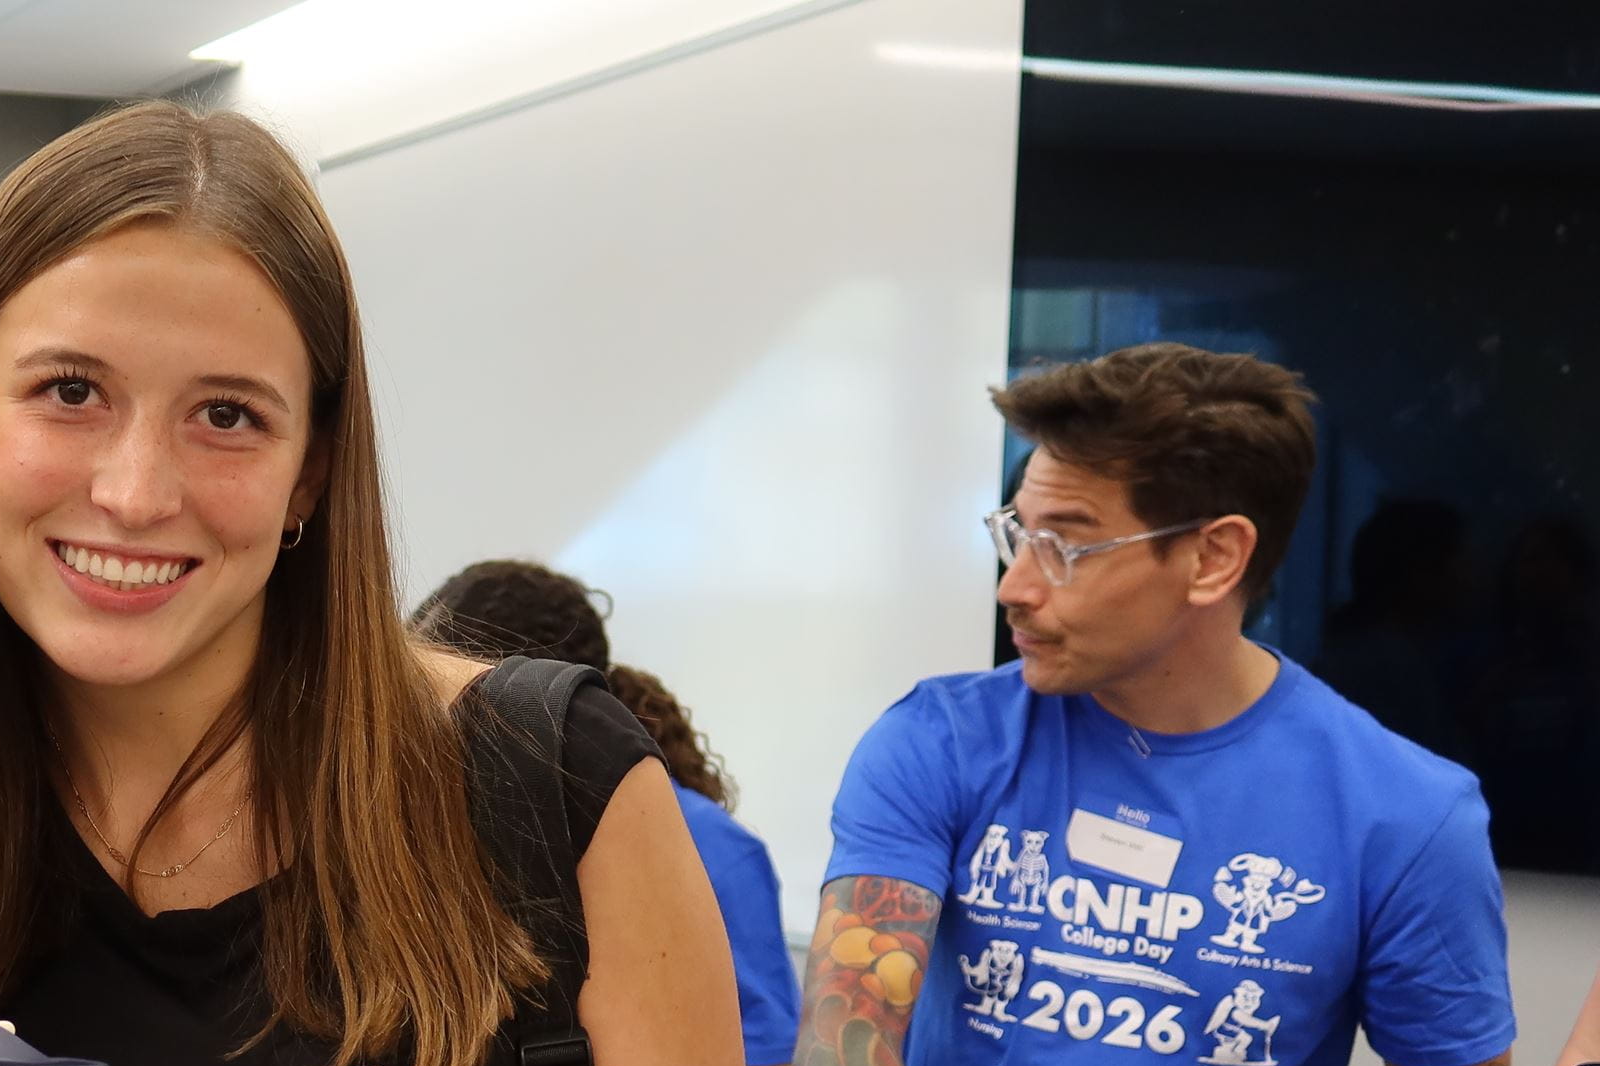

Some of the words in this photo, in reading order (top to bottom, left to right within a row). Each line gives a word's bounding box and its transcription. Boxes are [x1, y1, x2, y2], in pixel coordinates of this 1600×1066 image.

[1116, 803, 1151, 822] Hello
[967, 909, 1001, 927] Health
[1002, 915, 1041, 932] Science
[1047, 875, 1204, 941] CNHP
[1060, 924, 1131, 955] College
[1133, 936, 1175, 964] Day
[1196, 947, 1239, 968] Culinary
[1239, 955, 1261, 969] Arts
[1262, 958, 1272, 970] &
[1272, 958, 1314, 975] Science
[968, 1017, 1004, 1040] Nursing
[1022, 980, 1187, 1055] 2026
